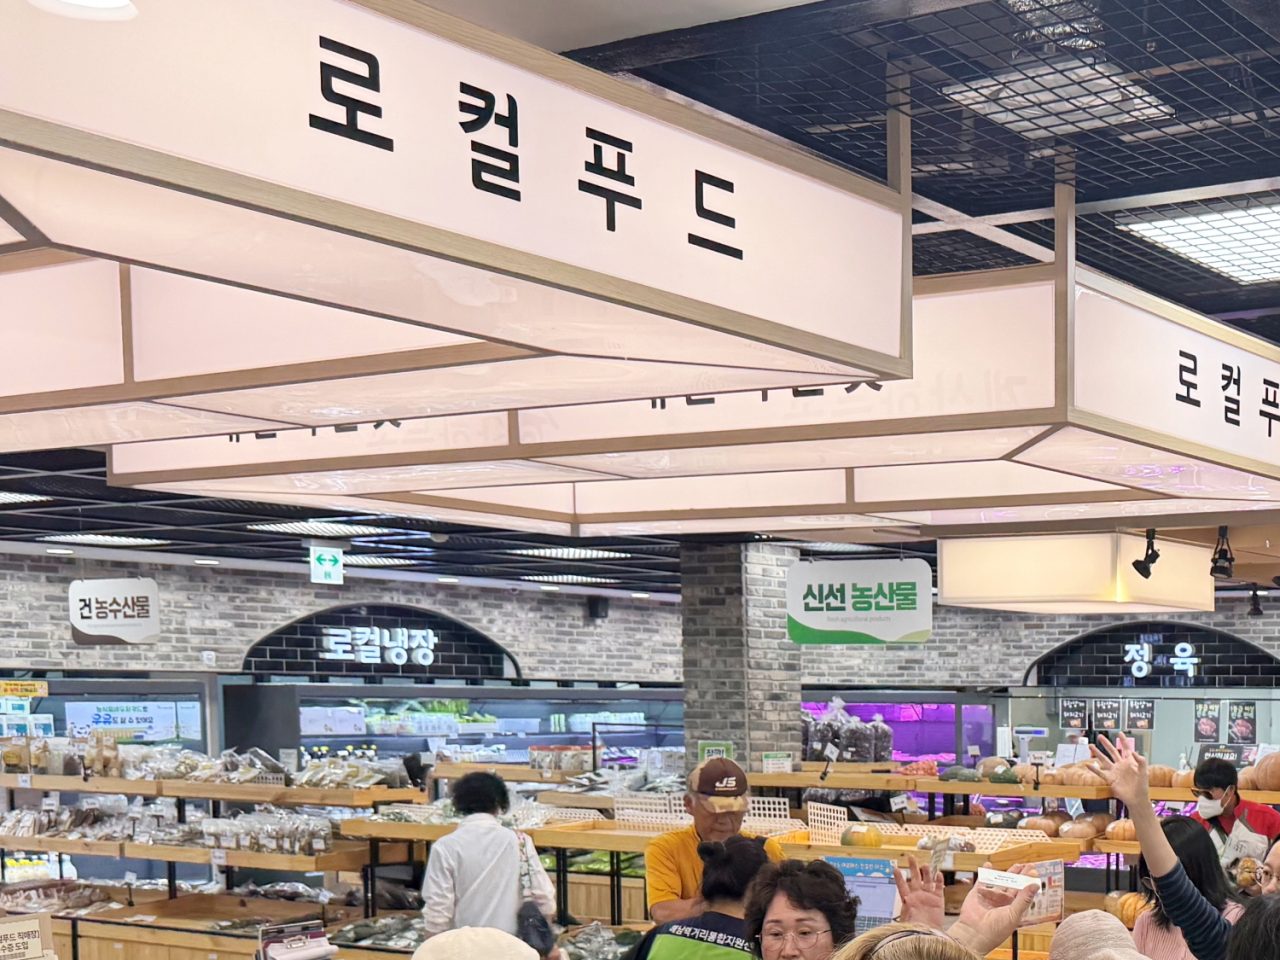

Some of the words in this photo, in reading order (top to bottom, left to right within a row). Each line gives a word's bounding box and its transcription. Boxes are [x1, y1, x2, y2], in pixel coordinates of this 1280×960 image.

[309, 34, 744, 260] 로컬푸드
[79, 597, 92, 619] 건
[95, 596, 150, 619] 농수산물
[803, 583, 846, 611] 신선
[851, 582, 917, 611] 농산물
[319, 626, 438, 665] 로컬냉장
[669, 925, 758, 951] 해남먹거리통합지원센
